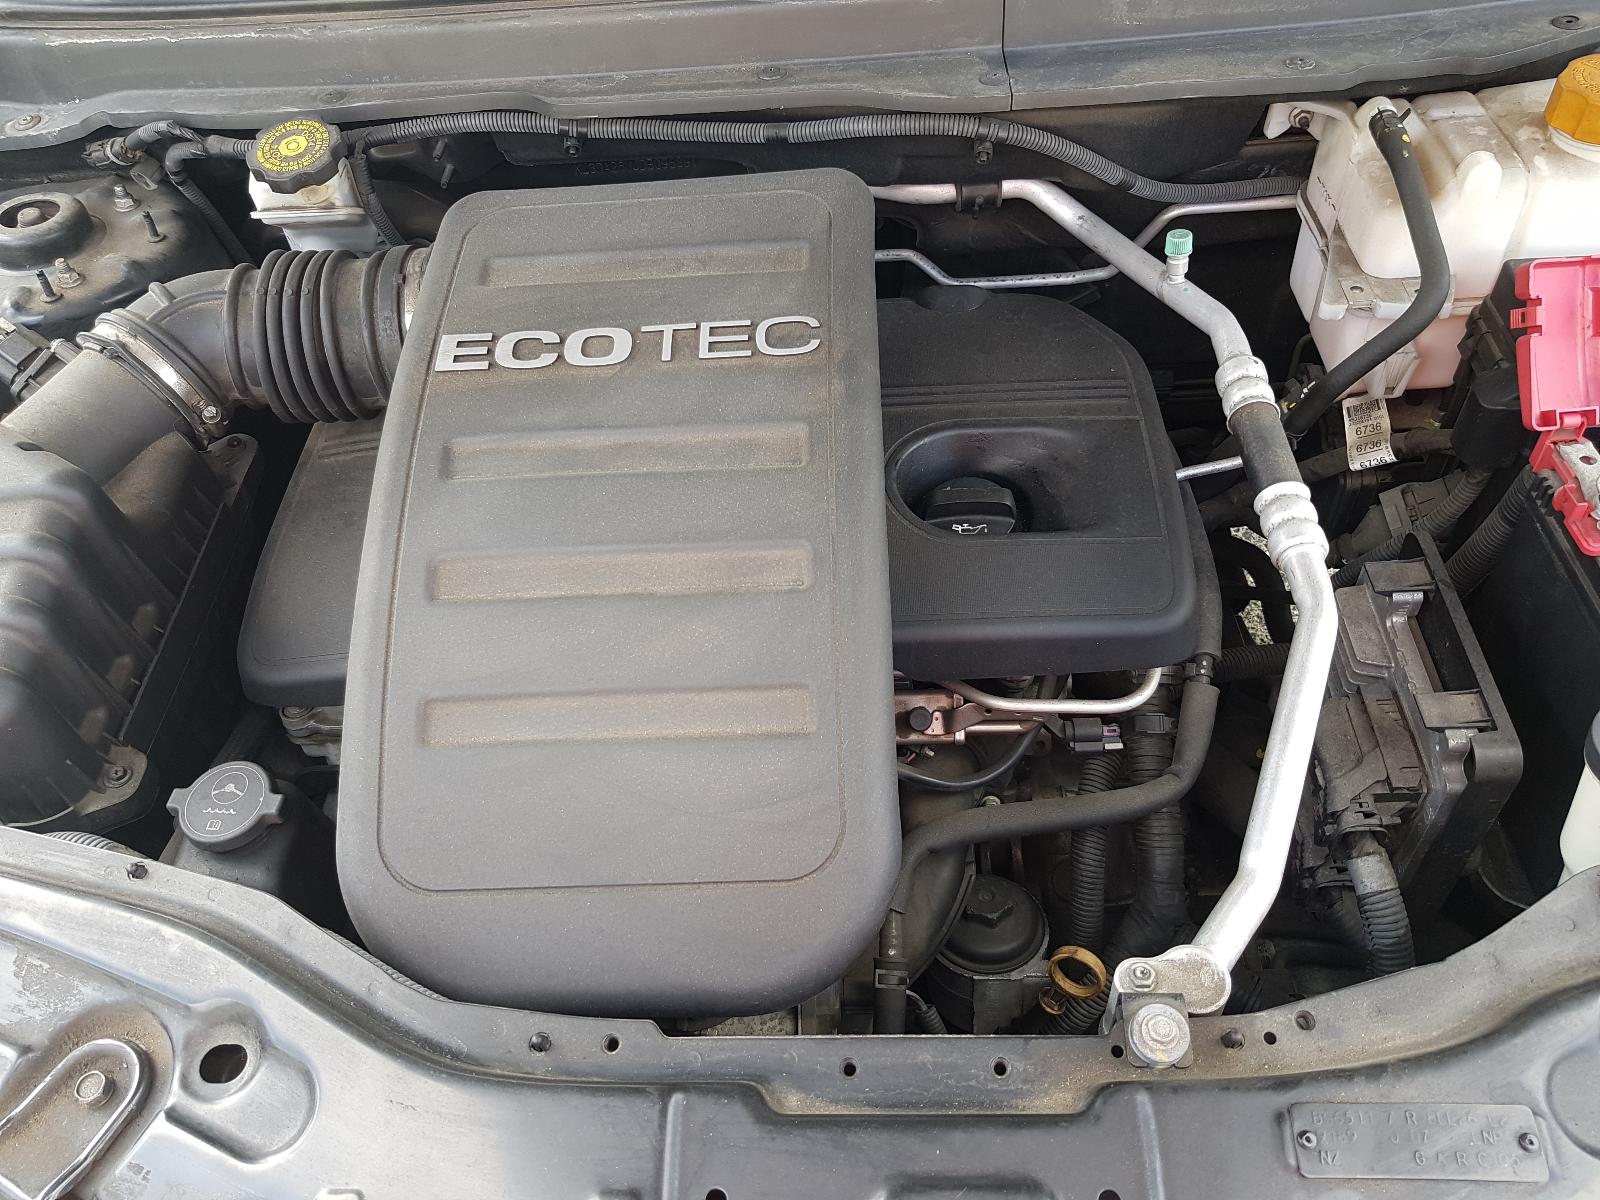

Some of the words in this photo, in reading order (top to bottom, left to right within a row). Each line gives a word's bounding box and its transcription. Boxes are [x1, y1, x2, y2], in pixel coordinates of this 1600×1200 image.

[434, 315, 821, 371] ECOTEC
[1355, 422, 1382, 435] 6736
[1356, 440, 1382, 453] 6736
[1359, 456, 1387, 469] 6736
